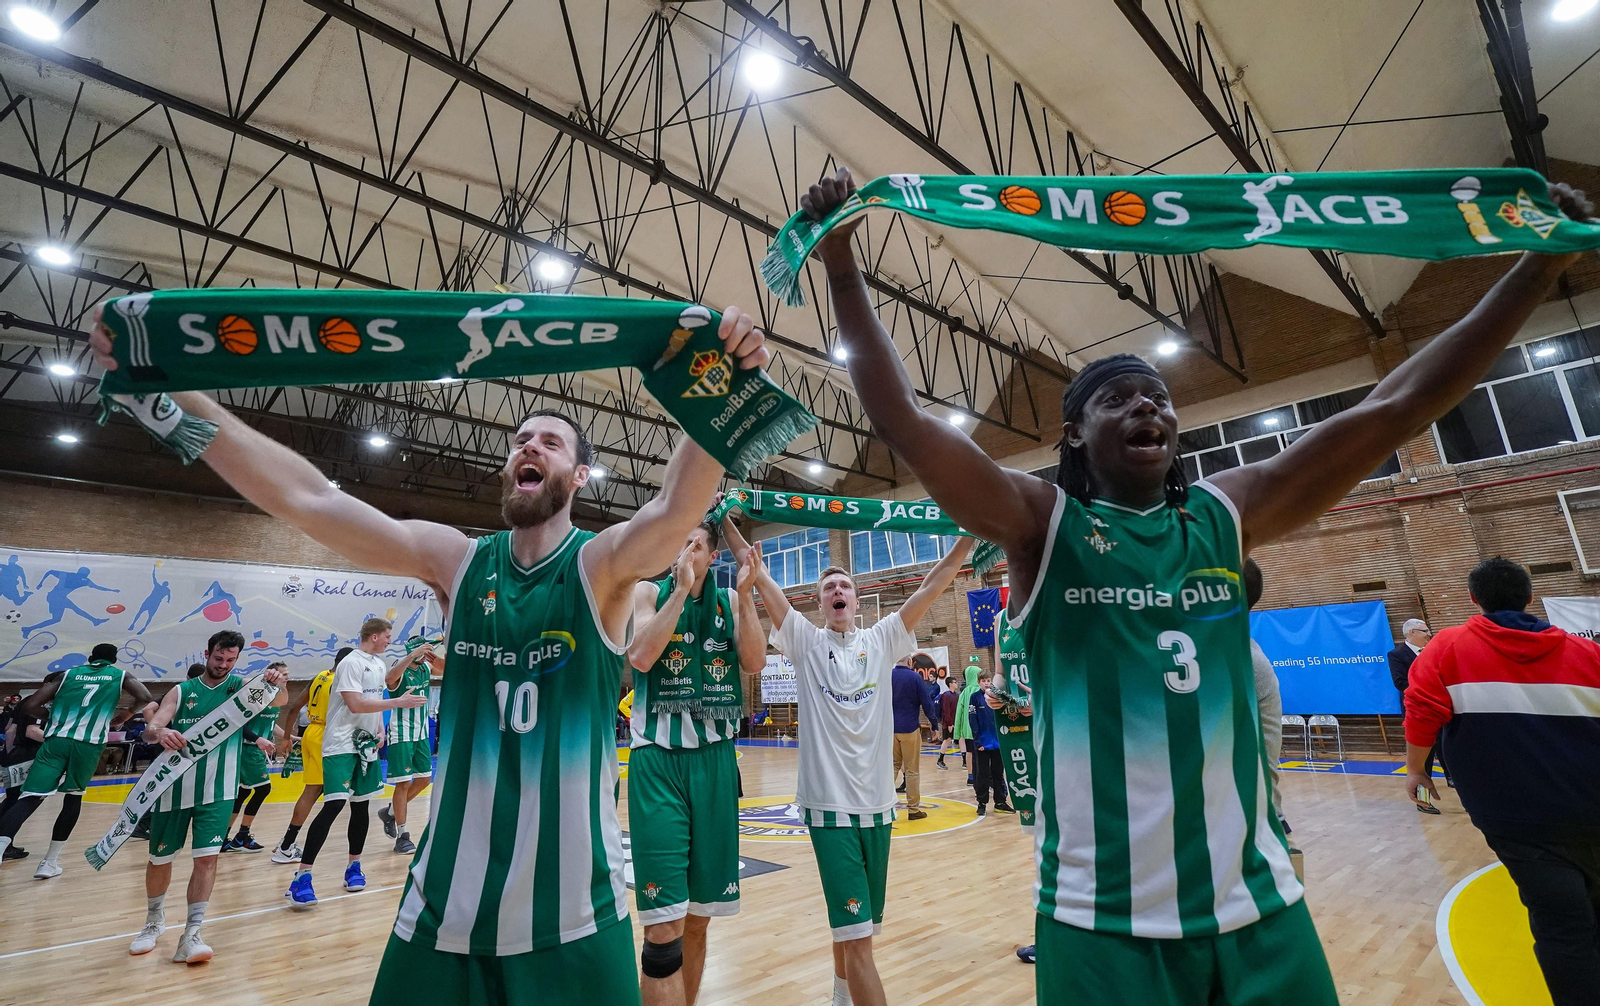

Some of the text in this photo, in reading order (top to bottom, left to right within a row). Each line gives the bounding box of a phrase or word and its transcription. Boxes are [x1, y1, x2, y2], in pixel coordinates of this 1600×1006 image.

[1283, 194, 1409, 224] ACB
[494, 320, 619, 347] ACB
[757, 397, 777, 417] plus
[892, 504, 941, 520] ACB
[312, 578, 348, 595] Real
[352, 581, 397, 598] Canoe
[1064, 581, 1231, 611] energía plus
[528, 643, 562, 669] pus
[1157, 630, 1201, 693] 3
[1271, 655, 1385, 668] eading 5G Innovations
[660, 677, 692, 685] RealBetis
[1010, 664, 1029, 684] 40
[82, 684, 100, 707] 7
[703, 684, 733, 692] RealBetis
[854, 689, 873, 703] plus
[494, 680, 539, 733] 10
[1011, 747, 1028, 787] ACB
